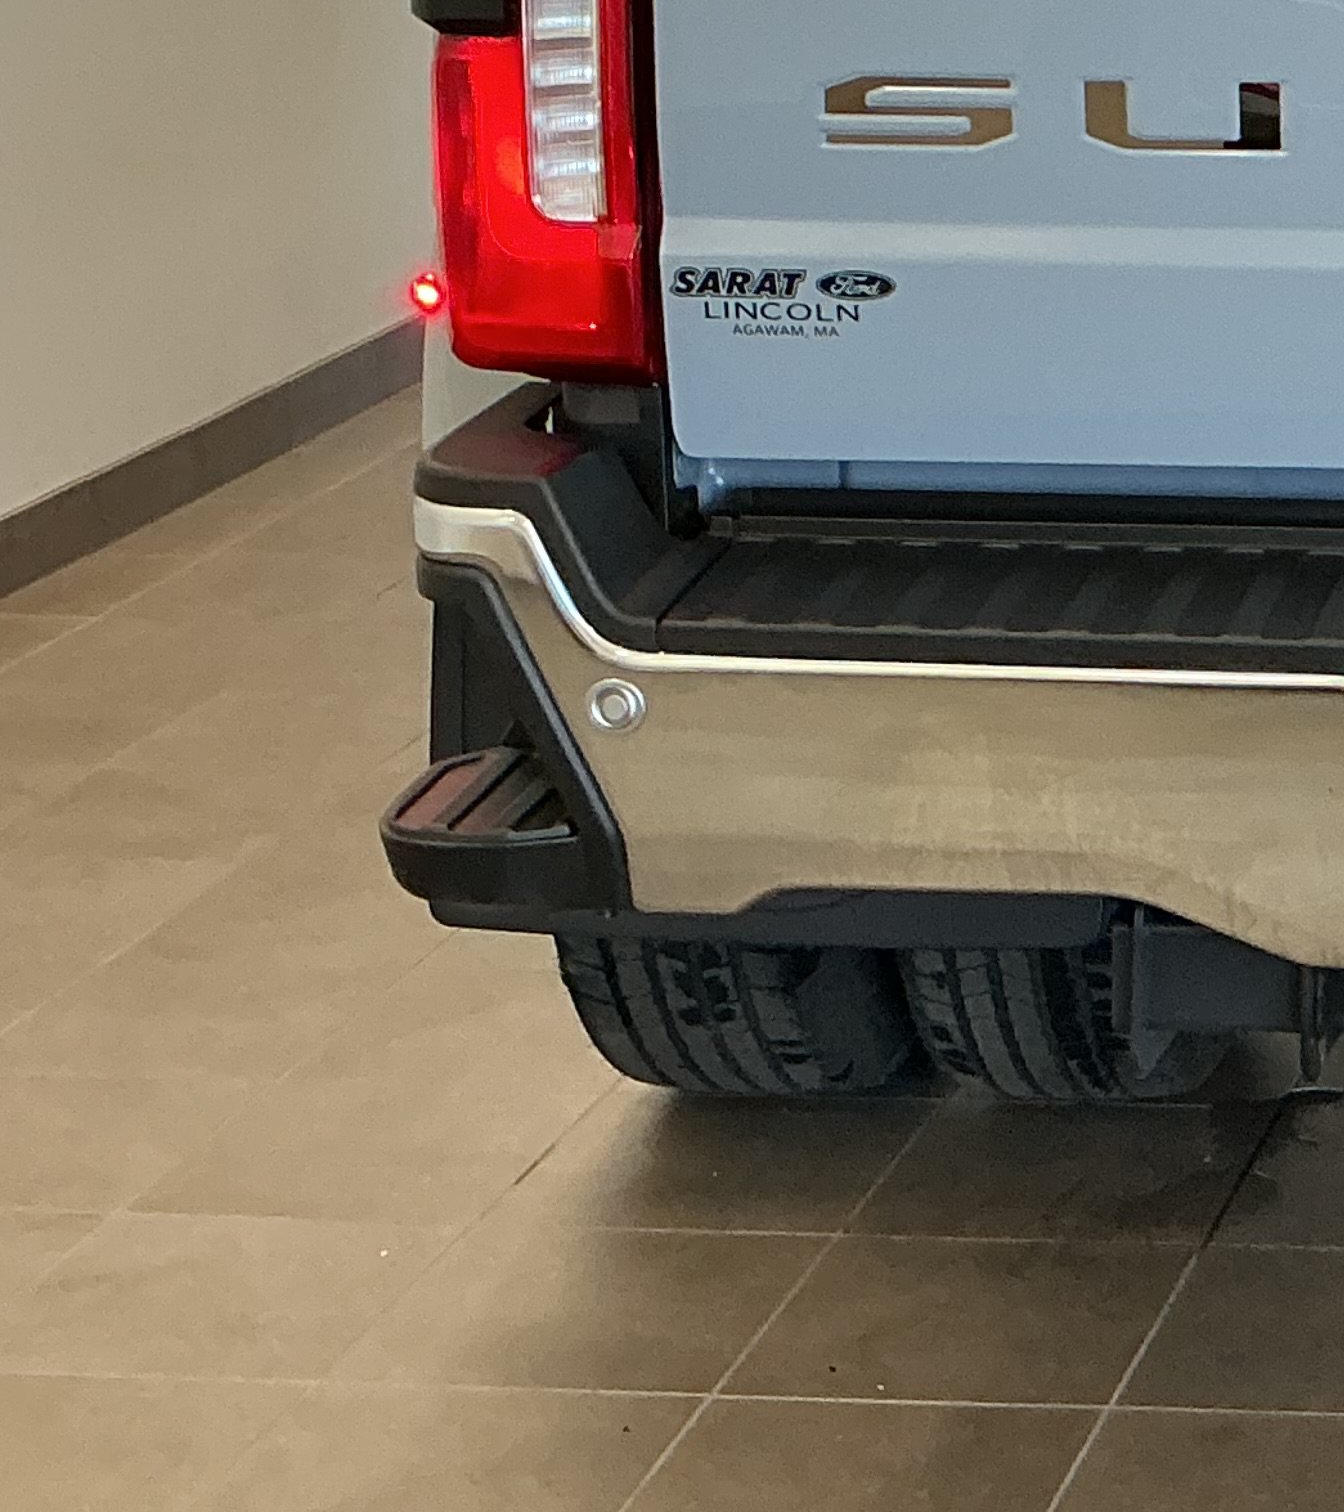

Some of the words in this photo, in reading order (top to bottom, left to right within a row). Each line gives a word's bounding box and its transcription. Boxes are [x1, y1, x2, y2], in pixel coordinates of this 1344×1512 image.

[670, 267, 806, 298] SARAT
[703, 301, 860, 322] LINCOLN
[732, 324, 809, 338] AGAWAM,
[814, 326, 840, 337] MA
